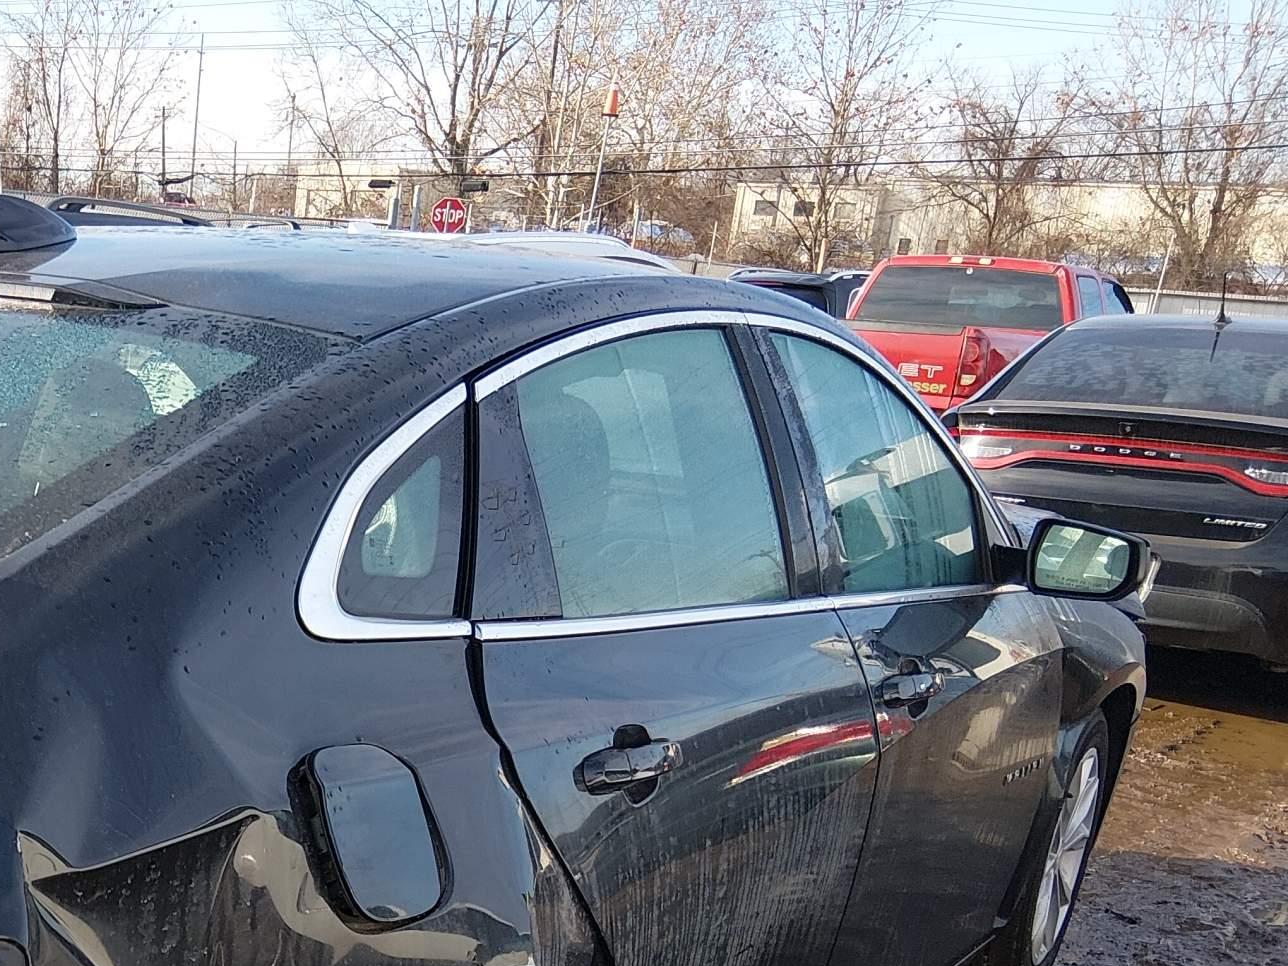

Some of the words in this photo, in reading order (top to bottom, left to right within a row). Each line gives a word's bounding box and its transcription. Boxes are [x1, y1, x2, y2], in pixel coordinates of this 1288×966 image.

[433, 208, 463, 223] STOP
[1069, 443, 1182, 459] DODGE
[1203, 517, 1268, 529] LIMITED
